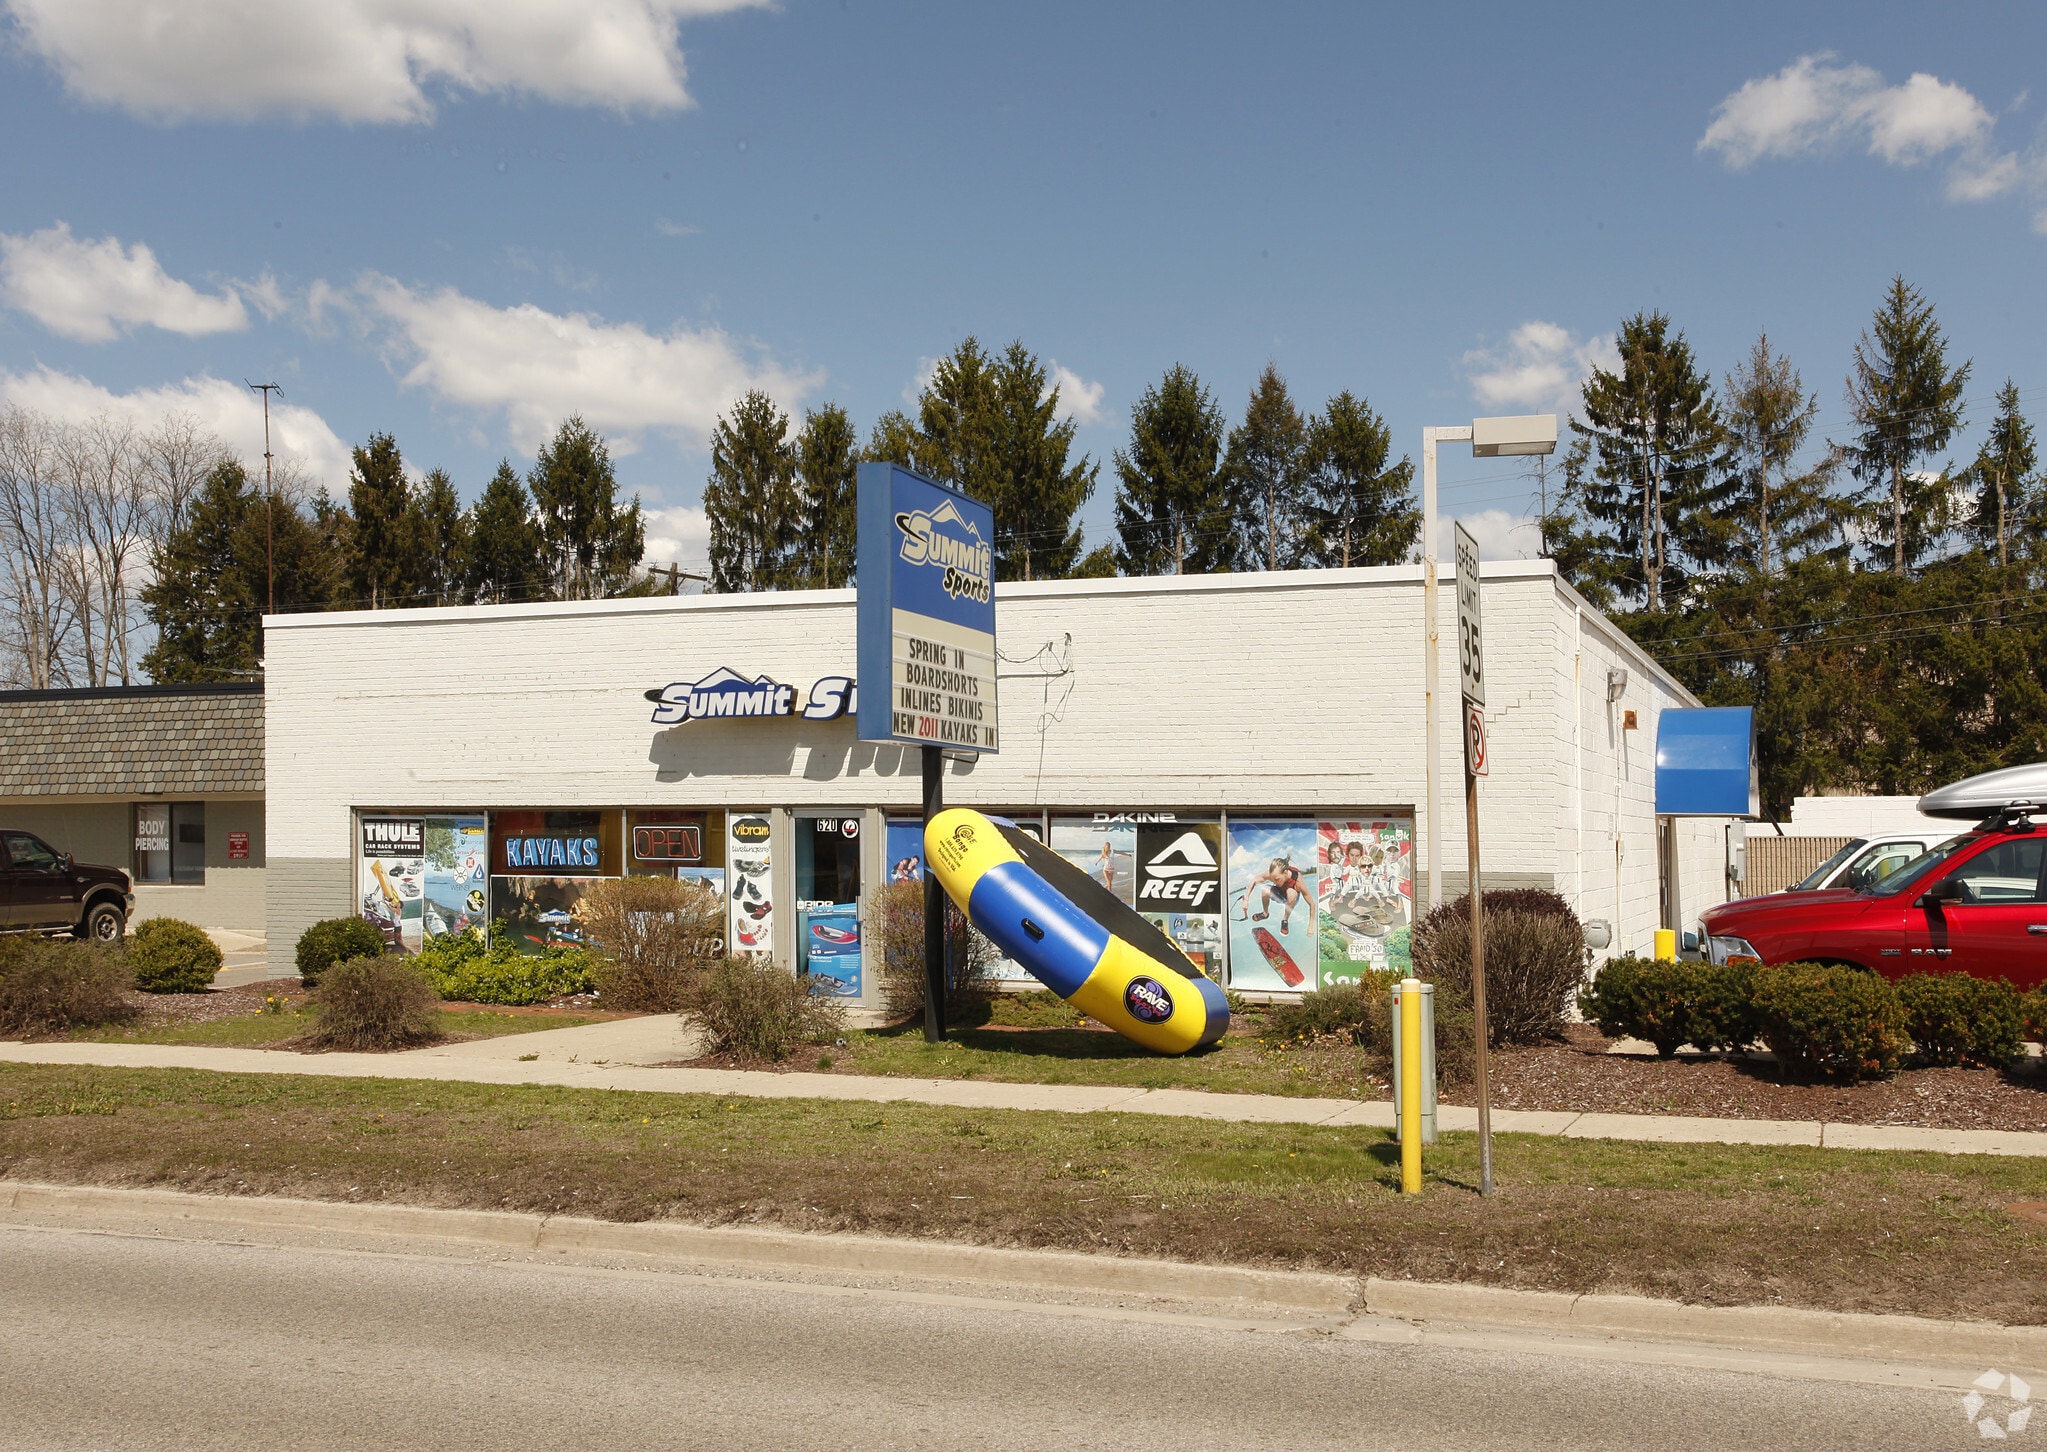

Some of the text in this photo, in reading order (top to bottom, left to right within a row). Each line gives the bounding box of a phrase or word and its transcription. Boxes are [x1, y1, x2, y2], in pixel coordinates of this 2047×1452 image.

[1458, 543, 1478, 582] SPEED
[943, 565, 990, 603] Sports
[1461, 582, 1477, 614] LIMIT
[909, 638, 965, 671] SPRING IN
[1461, 615, 1480, 684] 35
[906, 663, 979, 697] BOARDSHORTS
[901, 687, 983, 721] INLINES BIKINIS
[893, 712, 995, 747] NEW 2011 KAYAKS IN
[139, 820, 165, 836] BODY
[364, 822, 421, 842] THULE
[733, 823, 770, 836] vibram
[819, 819, 836, 831] 620
[1092, 812, 1178, 823] DAKINE
[135, 837, 169, 851] PIERCING
[506, 837, 598, 867] KAYAKS
[636, 829, 699, 858] OPEN
[1139, 879, 1219, 907] REEF
[1911, 948, 1952, 956] RAM
[1133, 984, 1169, 1012] RAVE
